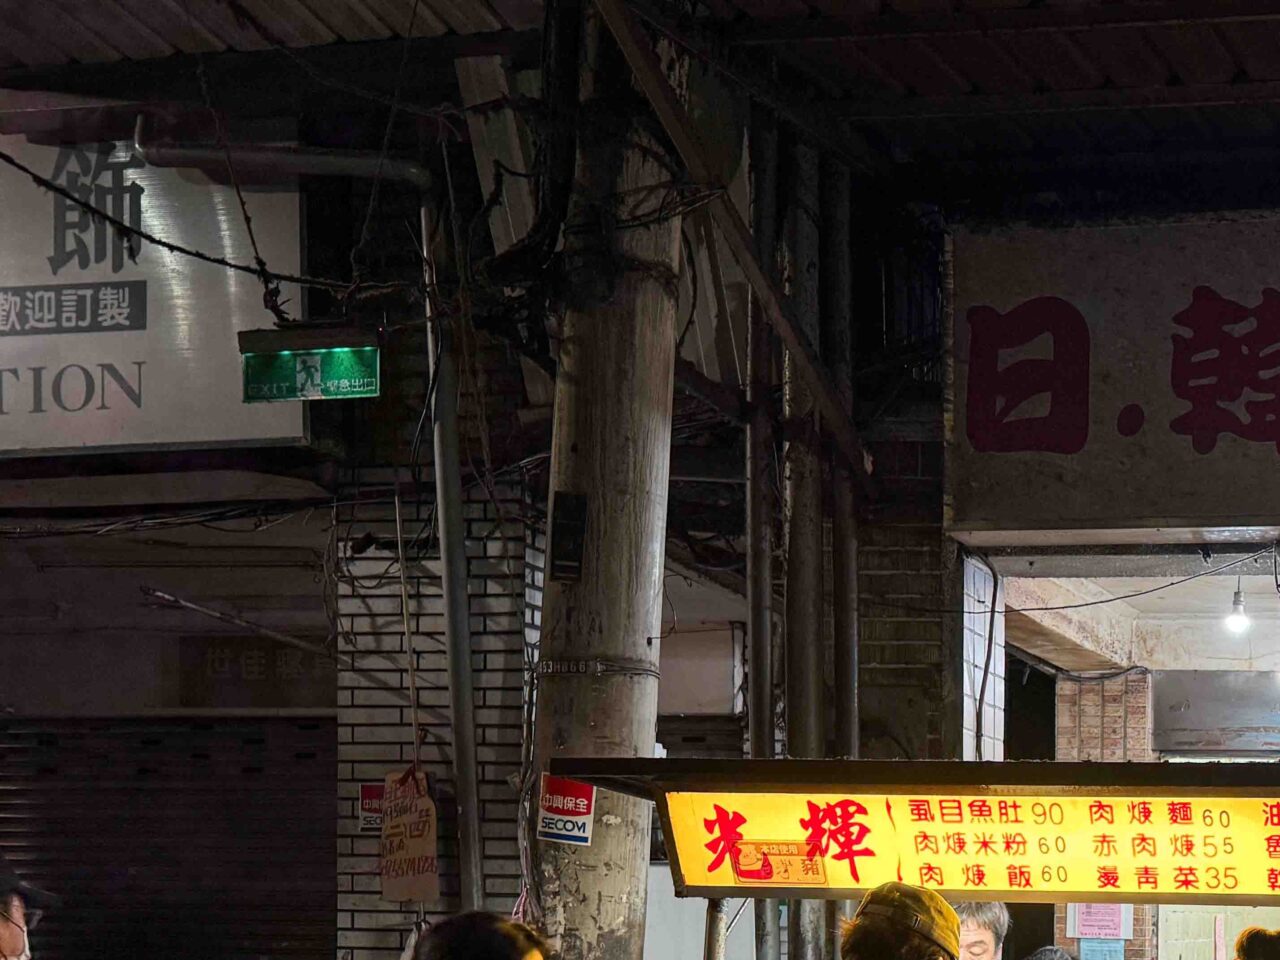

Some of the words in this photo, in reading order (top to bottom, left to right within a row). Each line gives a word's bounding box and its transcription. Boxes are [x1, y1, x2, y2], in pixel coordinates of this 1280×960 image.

[47, 141, 146, 275] 飾
[908, 798, 1024, 824] 虱目魚肚
[1031, 802, 1065, 825] 90
[1202, 808, 1231, 828] 60
[541, 815, 587, 834] SECOM
[703, 799, 876, 884] 光輝
[1038, 835, 1067, 855] 60
[1203, 834, 1235, 858] 55
[1041, 865, 1069, 883] 60
[1205, 866, 1239, 890] 35
